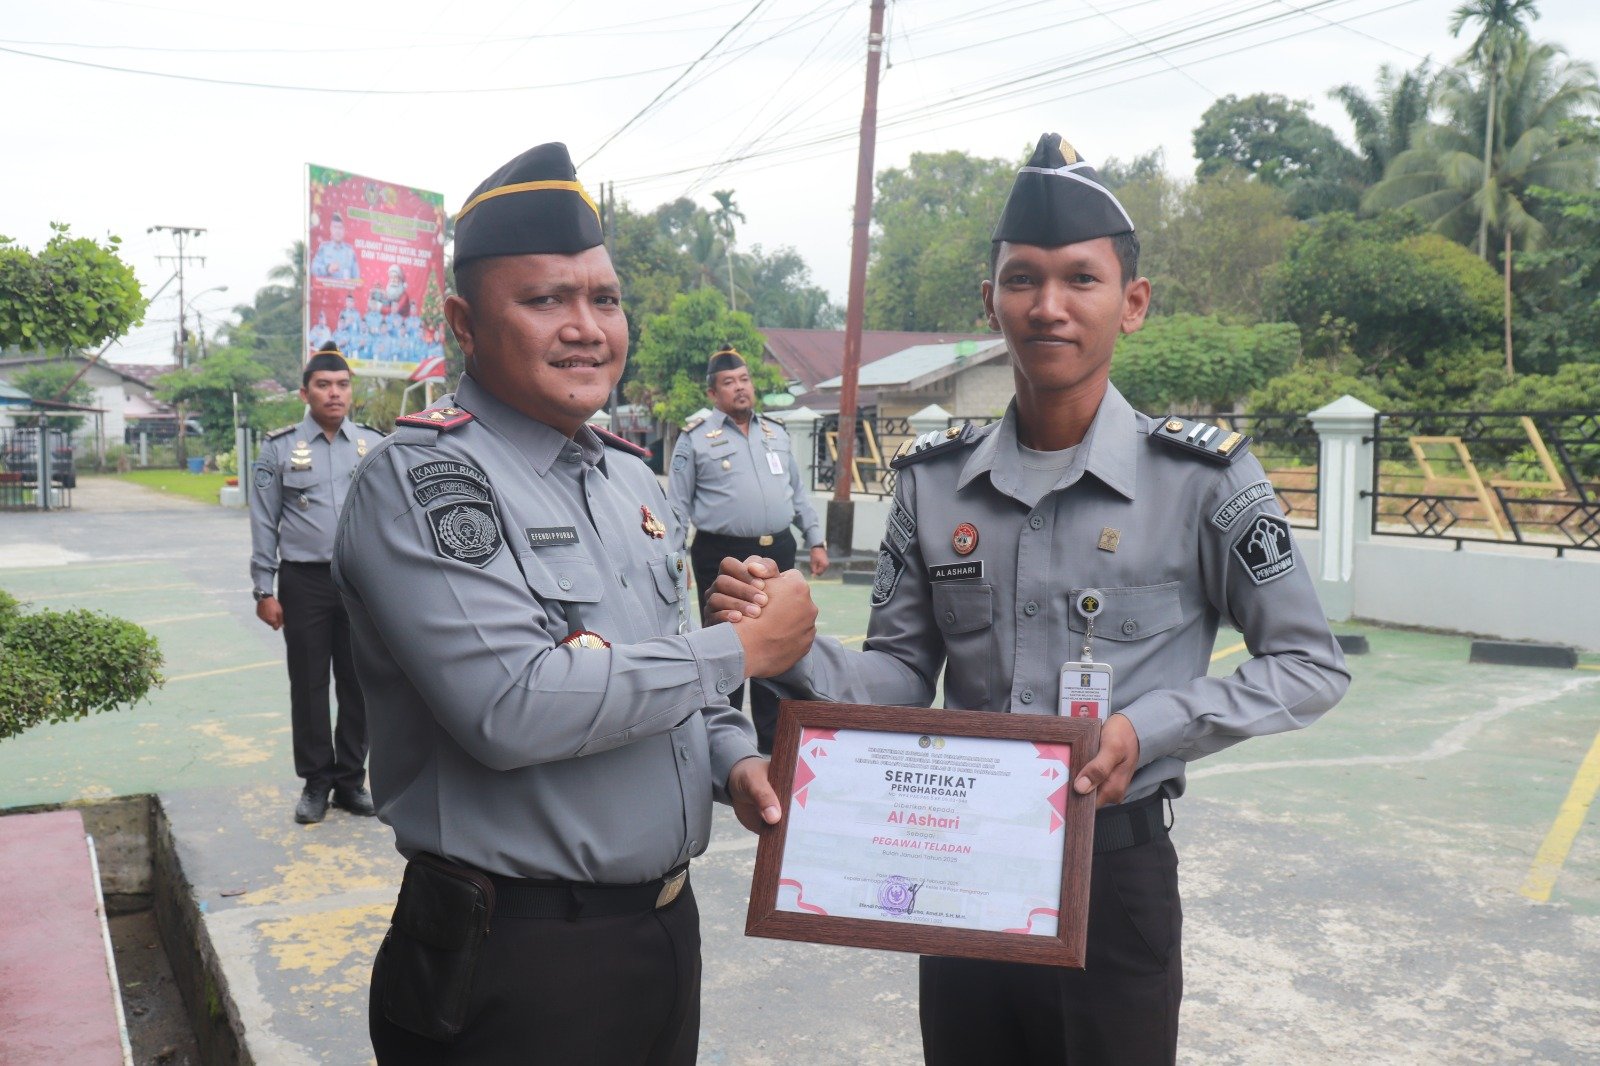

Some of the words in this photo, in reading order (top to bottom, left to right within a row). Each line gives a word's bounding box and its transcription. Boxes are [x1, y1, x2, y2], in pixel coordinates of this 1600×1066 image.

[415, 463, 457, 478] KANWIL
[947, 566, 976, 577] ASHARI
[885, 769, 977, 789] SERTIFIKAT
[891, 783, 967, 798] PENGHARGAAN
[893, 802, 926, 811] Diberikan
[928, 805, 955, 814] Kepada
[887, 810, 904, 824] Al
[907, 812, 960, 829] Ashari
[906, 830, 935, 839] Sebagai
[872, 836, 921, 849] PEGAWAI
[924, 841, 972, 854] TELADAN
